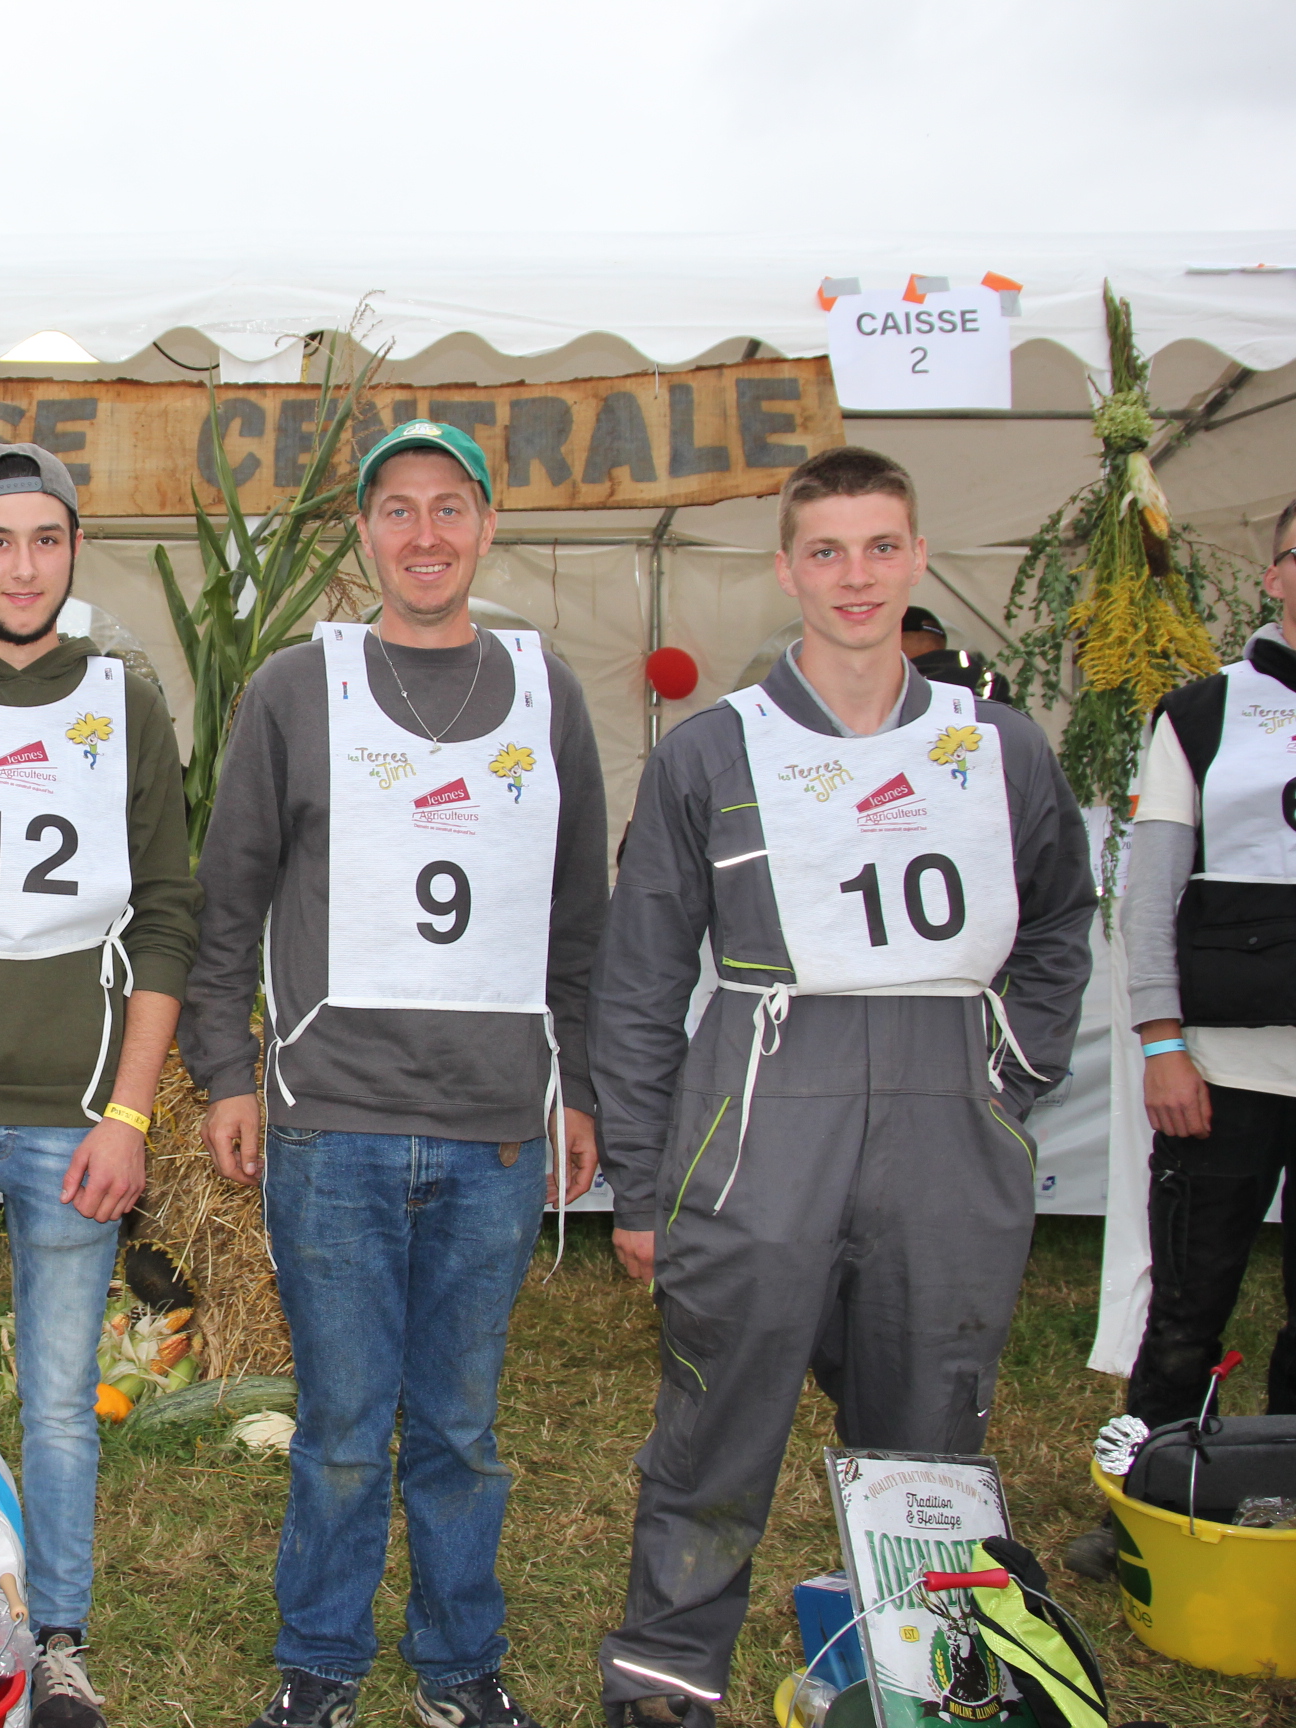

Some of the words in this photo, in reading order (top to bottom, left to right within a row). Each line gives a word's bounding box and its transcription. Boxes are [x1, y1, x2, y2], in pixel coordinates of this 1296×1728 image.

[856, 308, 980, 336] CAISSE
[910, 346, 929, 374] 2
[196, 377, 809, 489] CENTRALE
[1249, 704, 1296, 718] Terres
[6, 750, 44, 765] Jeunes
[354, 747, 408, 763] Terres
[0, 768, 57, 781] Agriculteurs
[369, 768, 381, 777] de
[375, 762, 416, 790] Jim
[778, 773, 791, 781] les
[784, 759, 842, 779] Terres
[804, 784, 817, 793] de
[808, 768, 854, 802] Jim
[426, 788, 465, 806] Jeunes
[868, 784, 909, 807] Jeunes
[418, 810, 479, 822] Agriculteurs
[864, 807, 927, 825] Agriculteurs
[415, 859, 471, 944] 9
[839, 852, 966, 947] 10
[867, 1473, 898, 1499] QUALITY
[896, 1470, 937, 1484] TRACTORS
[938, 1473, 954, 1488] AND
[956, 1479, 982, 1502] PLOWS
[905, 1492, 953, 1509] Tradition
[906, 1510, 915, 1524] &
[916, 1509, 962, 1530] Heritage
[864, 1529, 936, 1614] JOHN
[975, 1701, 1000, 1720] ILLINOIS
